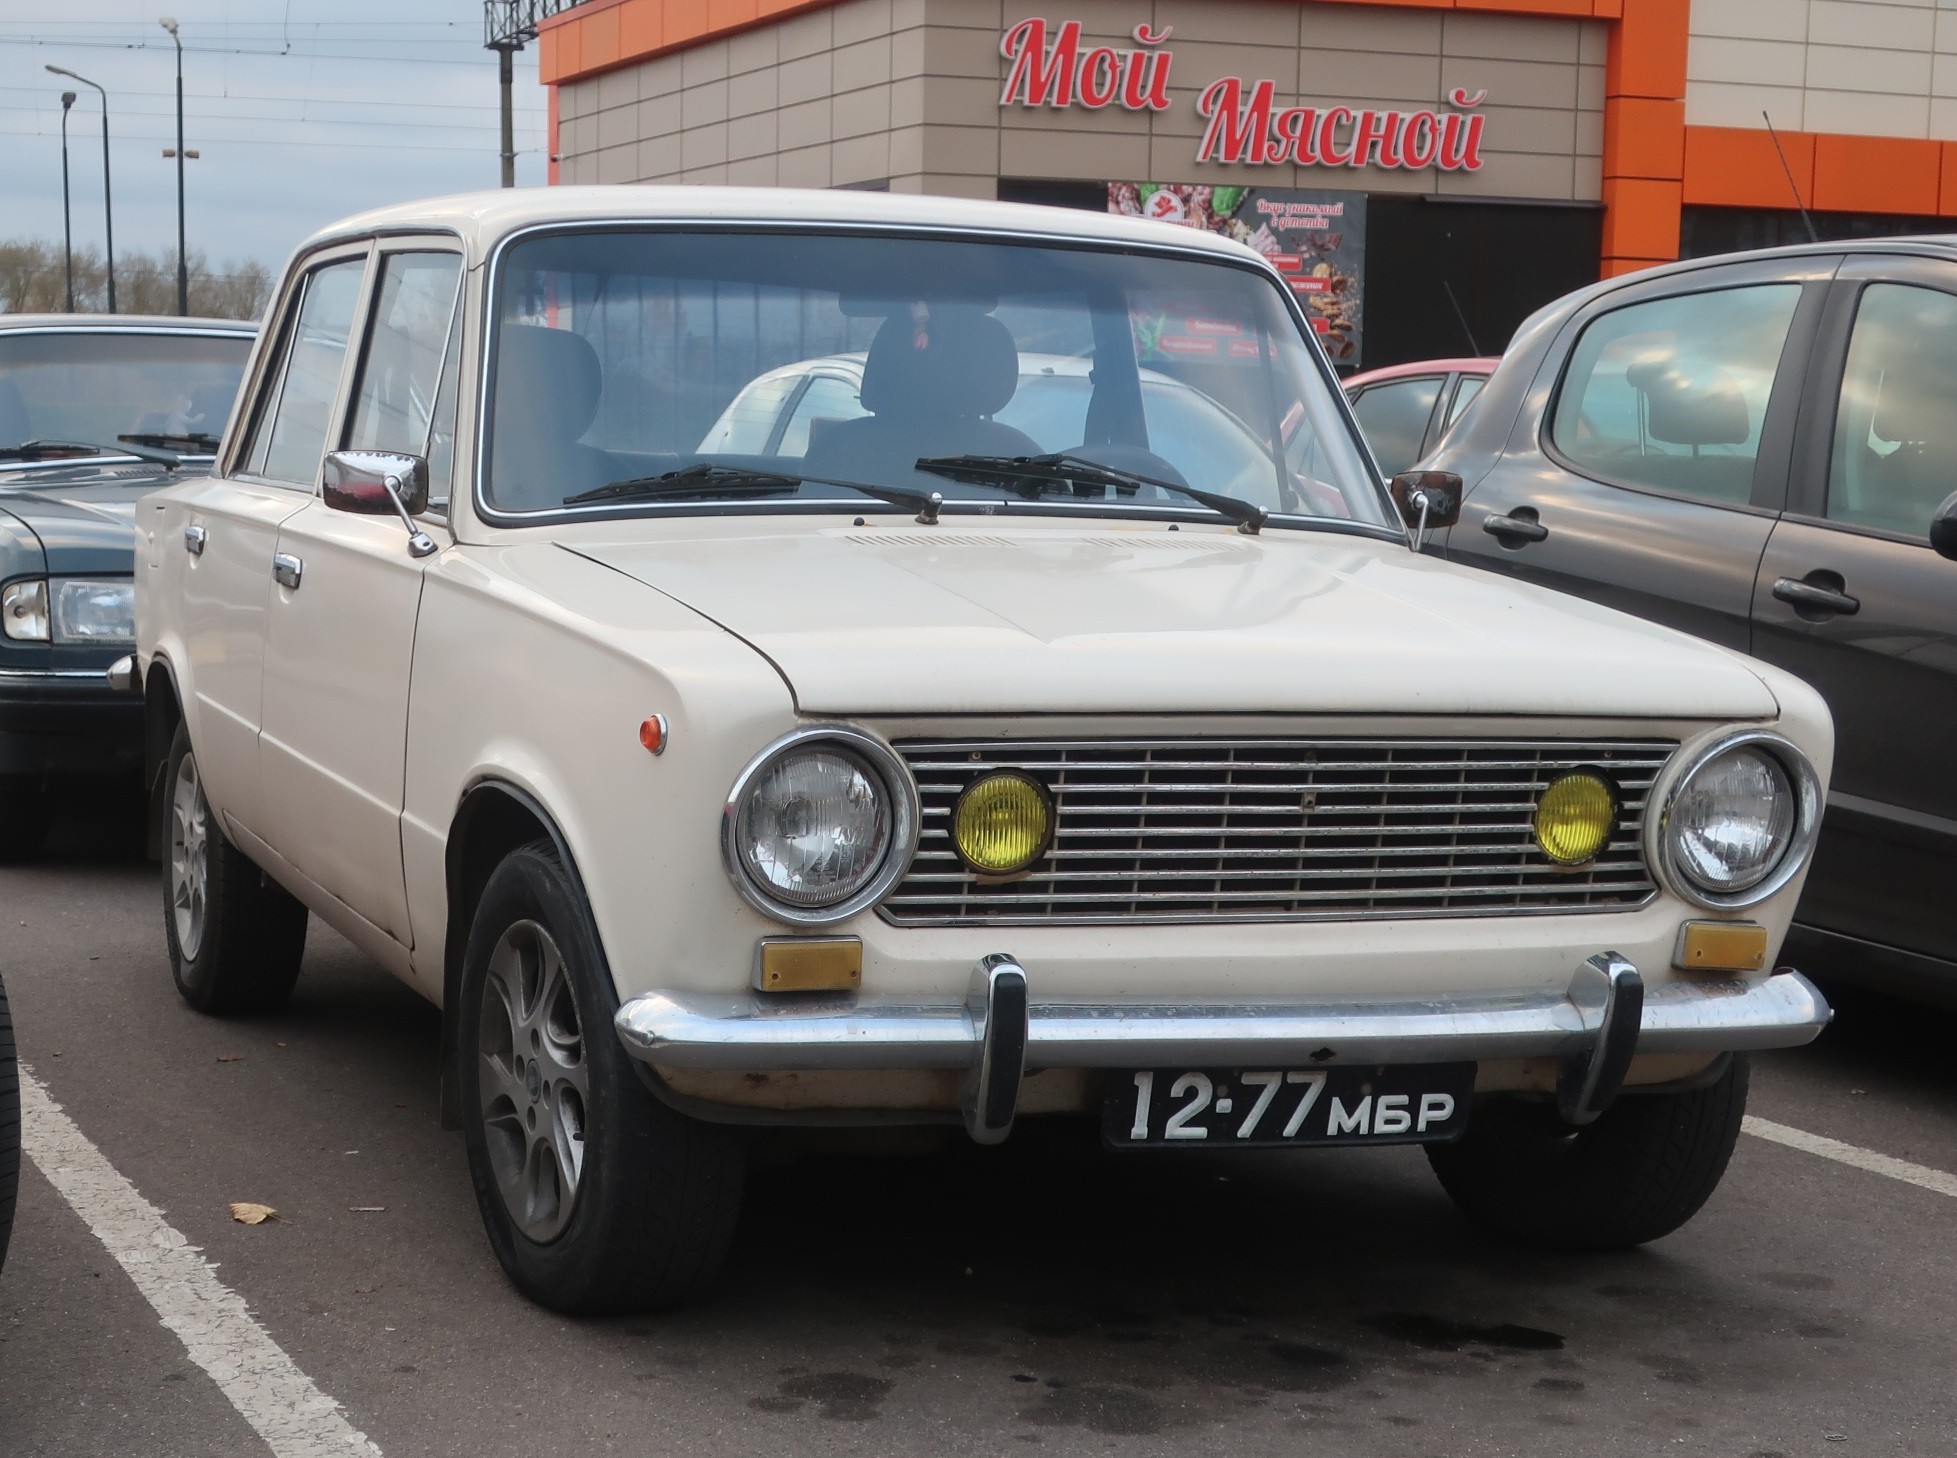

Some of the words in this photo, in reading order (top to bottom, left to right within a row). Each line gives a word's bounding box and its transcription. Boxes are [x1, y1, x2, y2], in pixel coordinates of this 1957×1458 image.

[1001, 17, 1173, 110] Мой
[1197, 77, 1487, 171] Мясной
[1130, 1071, 1328, 1140] 12-77
[1327, 1093, 1455, 1136] МБР
